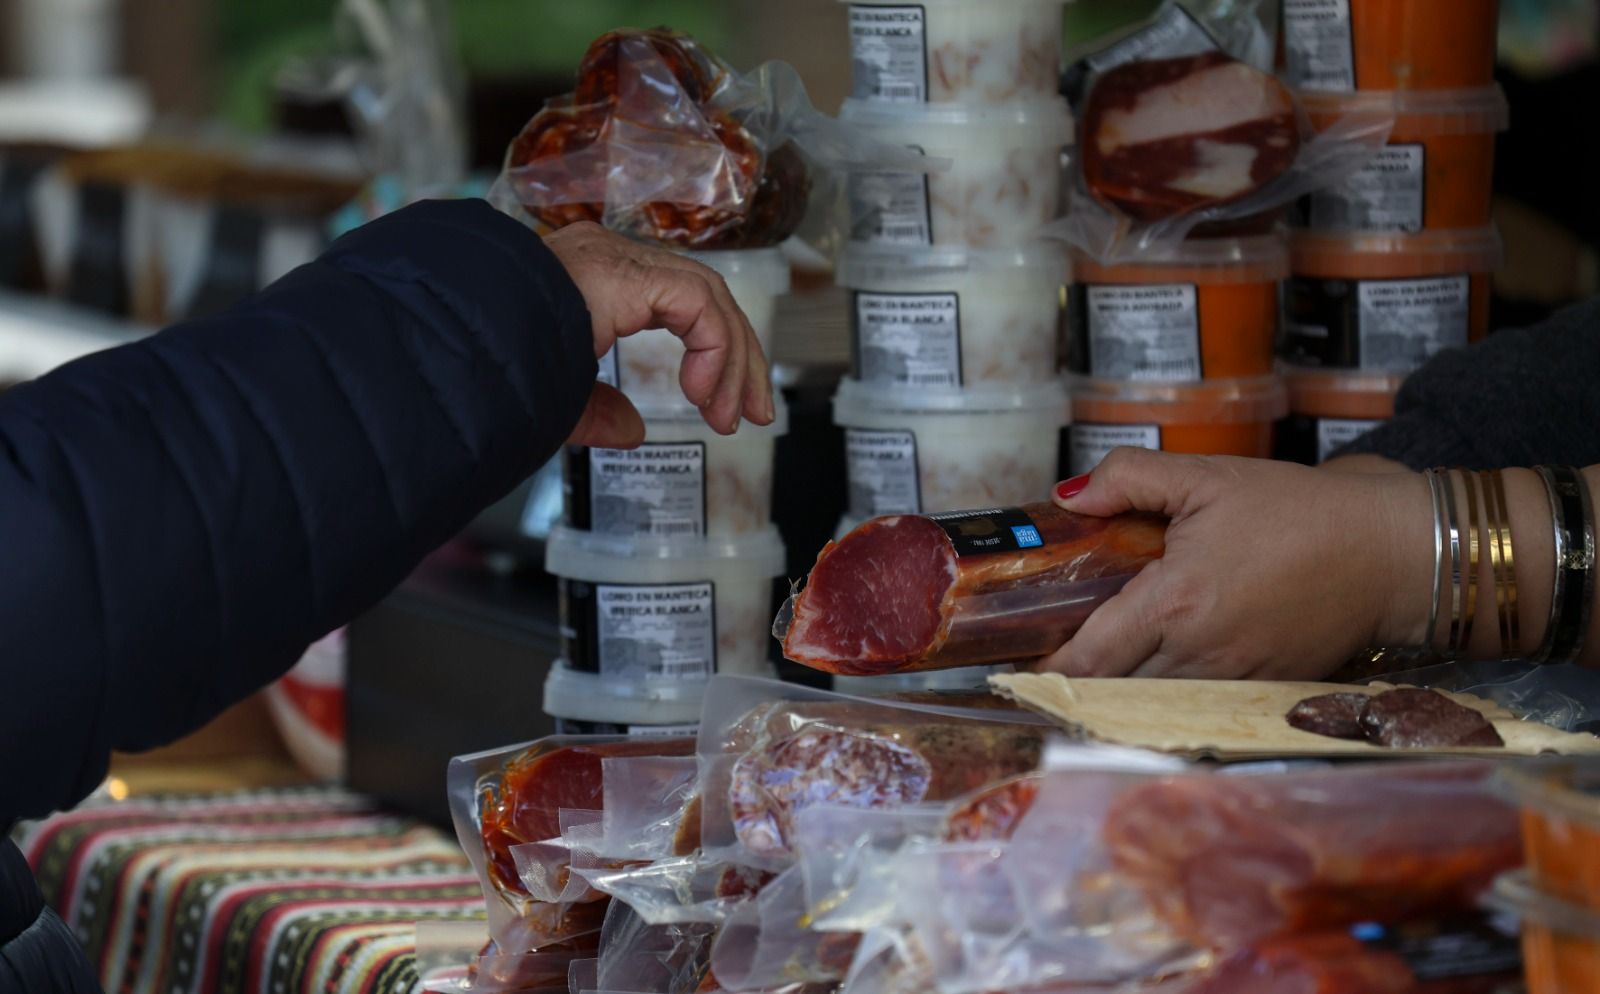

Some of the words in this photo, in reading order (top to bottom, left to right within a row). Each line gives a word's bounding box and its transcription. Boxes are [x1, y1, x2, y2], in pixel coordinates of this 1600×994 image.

[626, 449, 641, 460] EN
[644, 449, 700, 460] MANTECA
[645, 463, 692, 474] BLANCA
[601, 591, 633, 602] LOMO
[636, 591, 651, 602] EN
[654, 589, 710, 601] MANTECA
[655, 604, 702, 615] BLANCA
